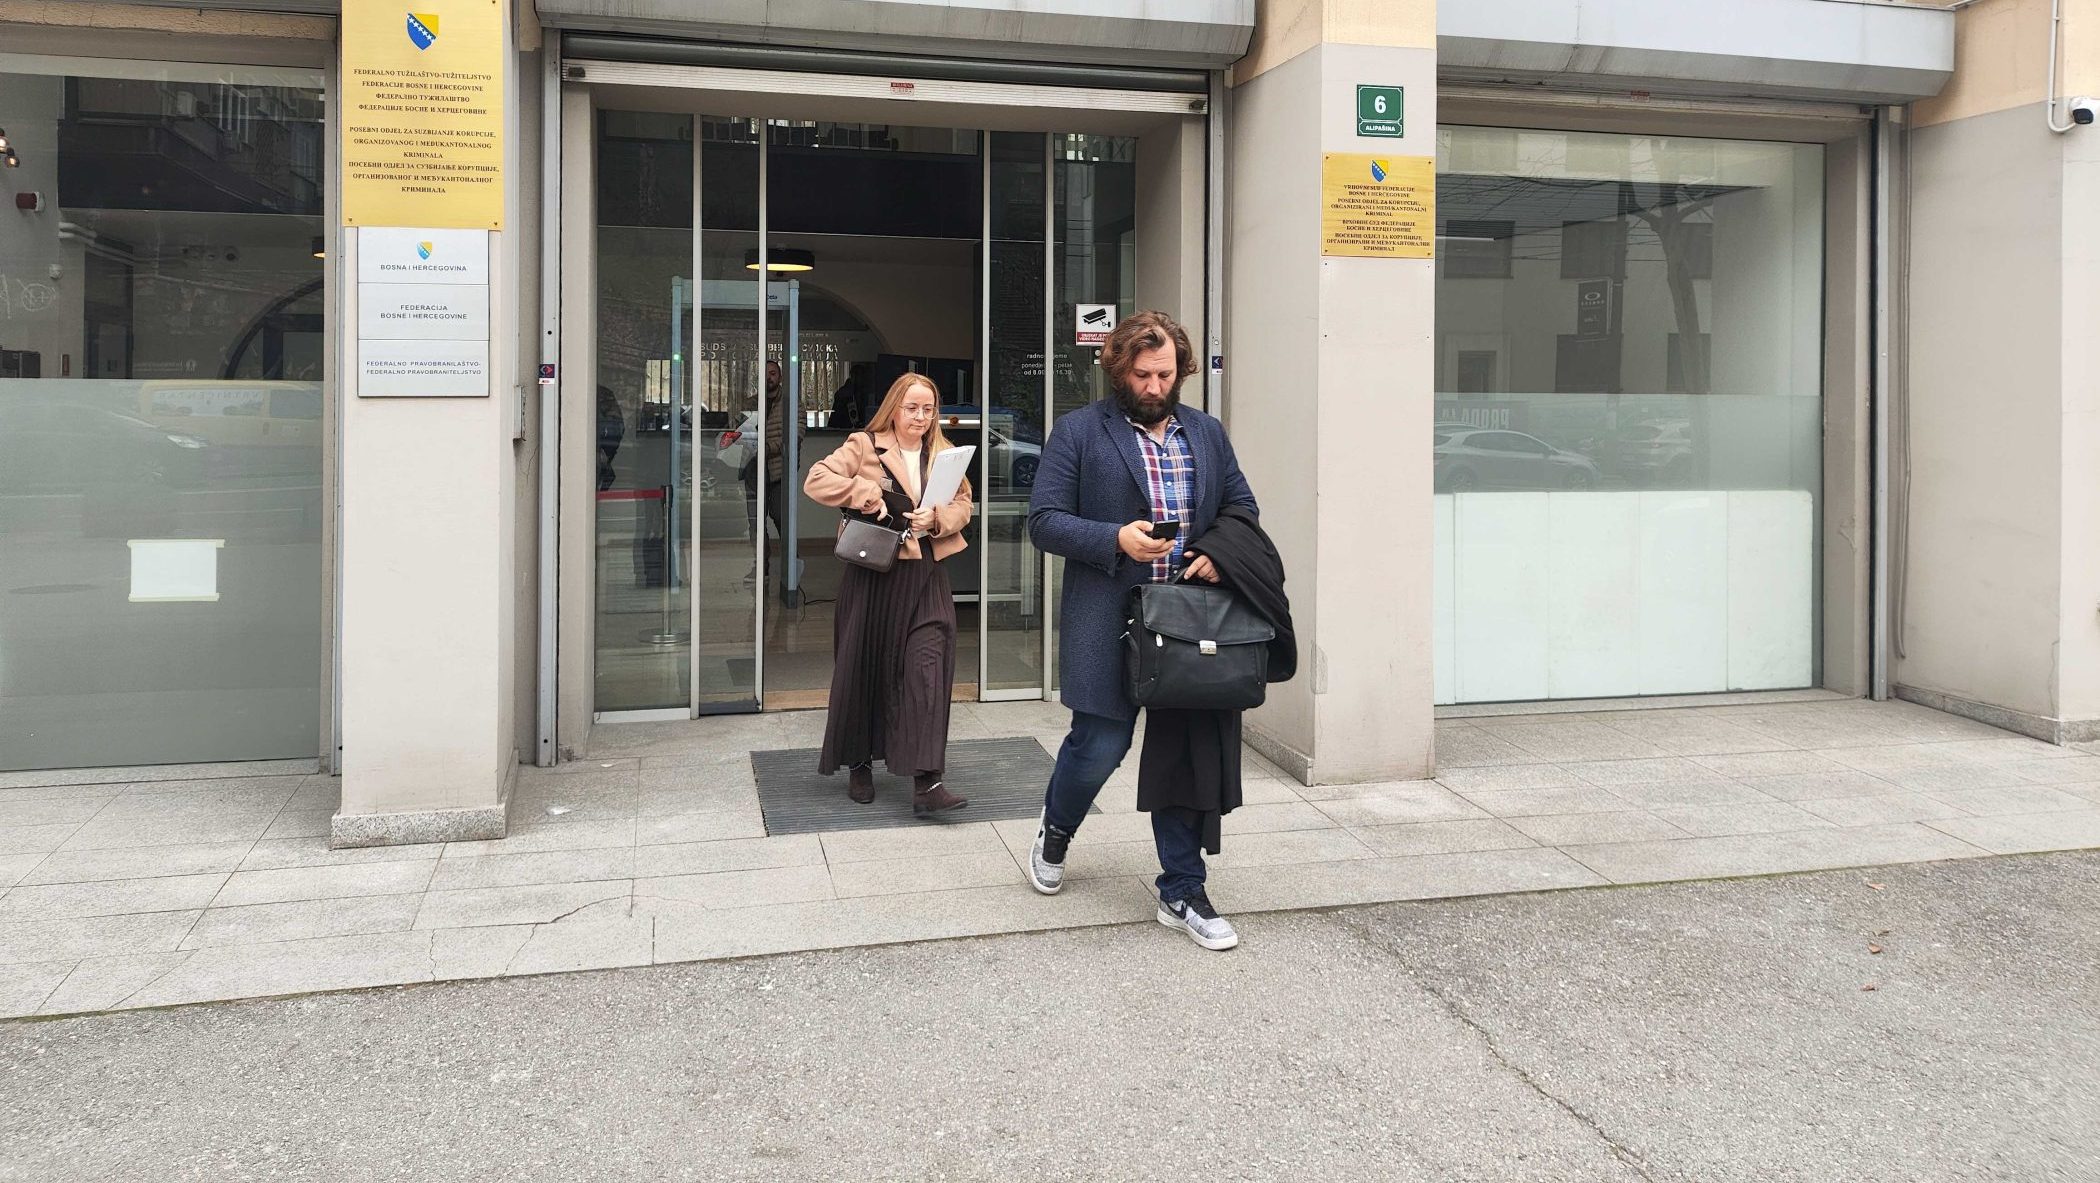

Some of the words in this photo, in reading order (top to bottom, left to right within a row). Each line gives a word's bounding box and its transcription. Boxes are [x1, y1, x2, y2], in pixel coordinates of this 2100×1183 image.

[434, 84, 484, 92] HERCEGOVINE
[419, 94, 470, 103] ТУЖИЛАШТВО
[1374, 96, 1387, 113] 6
[437, 107, 487, 115] ХЕРЦЕГОВИНЕ
